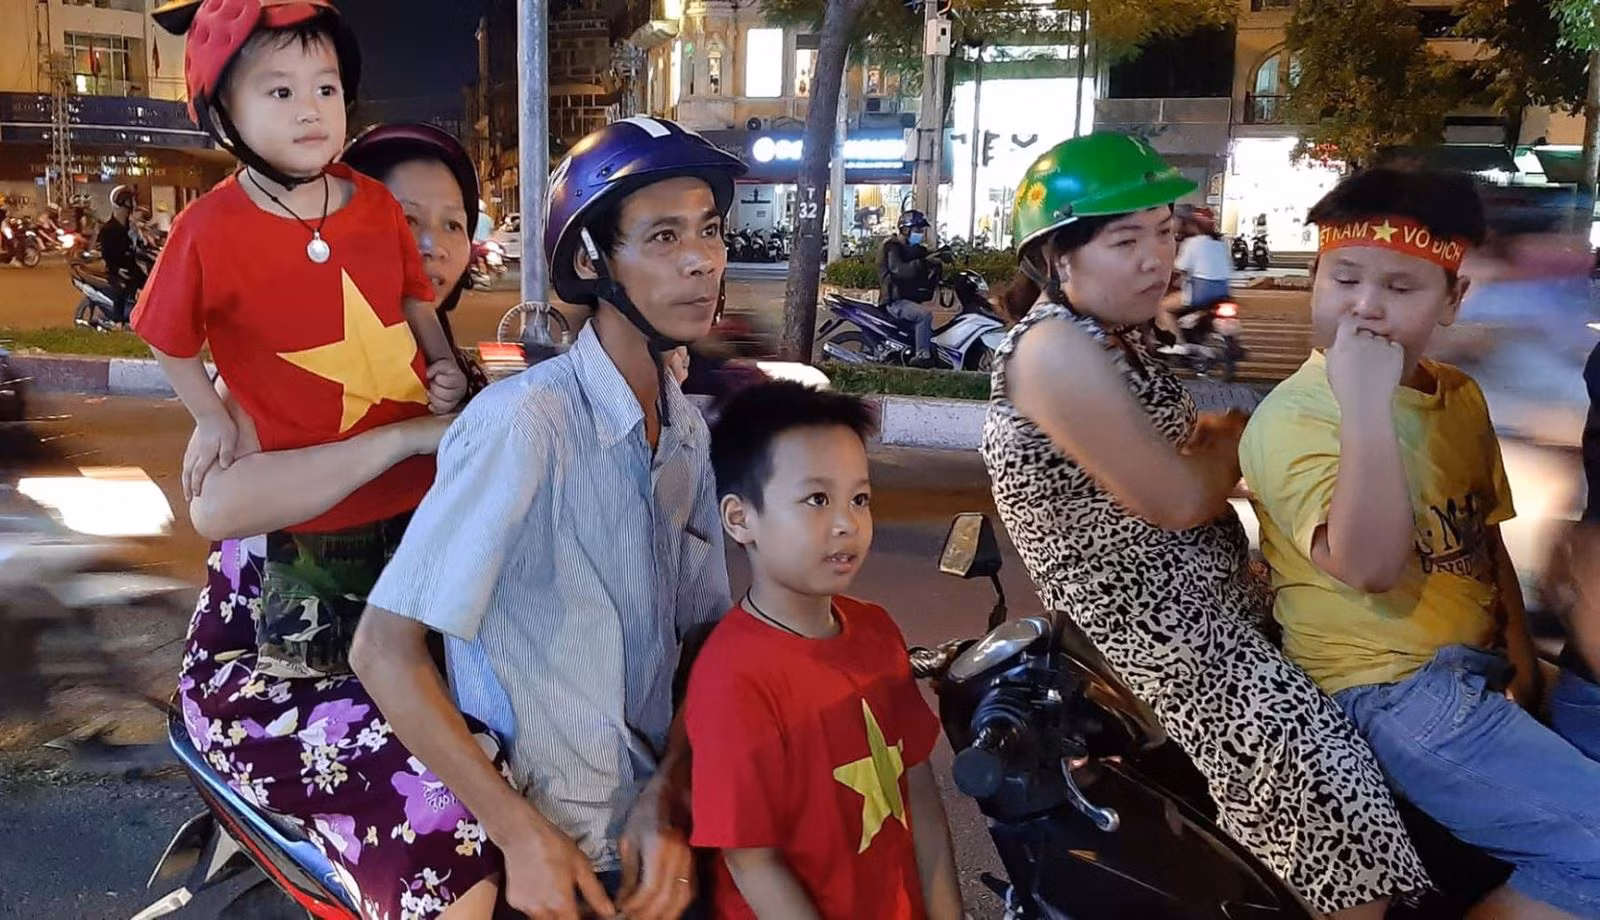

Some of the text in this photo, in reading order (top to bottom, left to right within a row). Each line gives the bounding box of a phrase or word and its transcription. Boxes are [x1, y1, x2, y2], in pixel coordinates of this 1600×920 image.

[807, 187, 816, 200] T
[799, 202, 818, 219] 32
[1332, 221, 1369, 241] NAM
